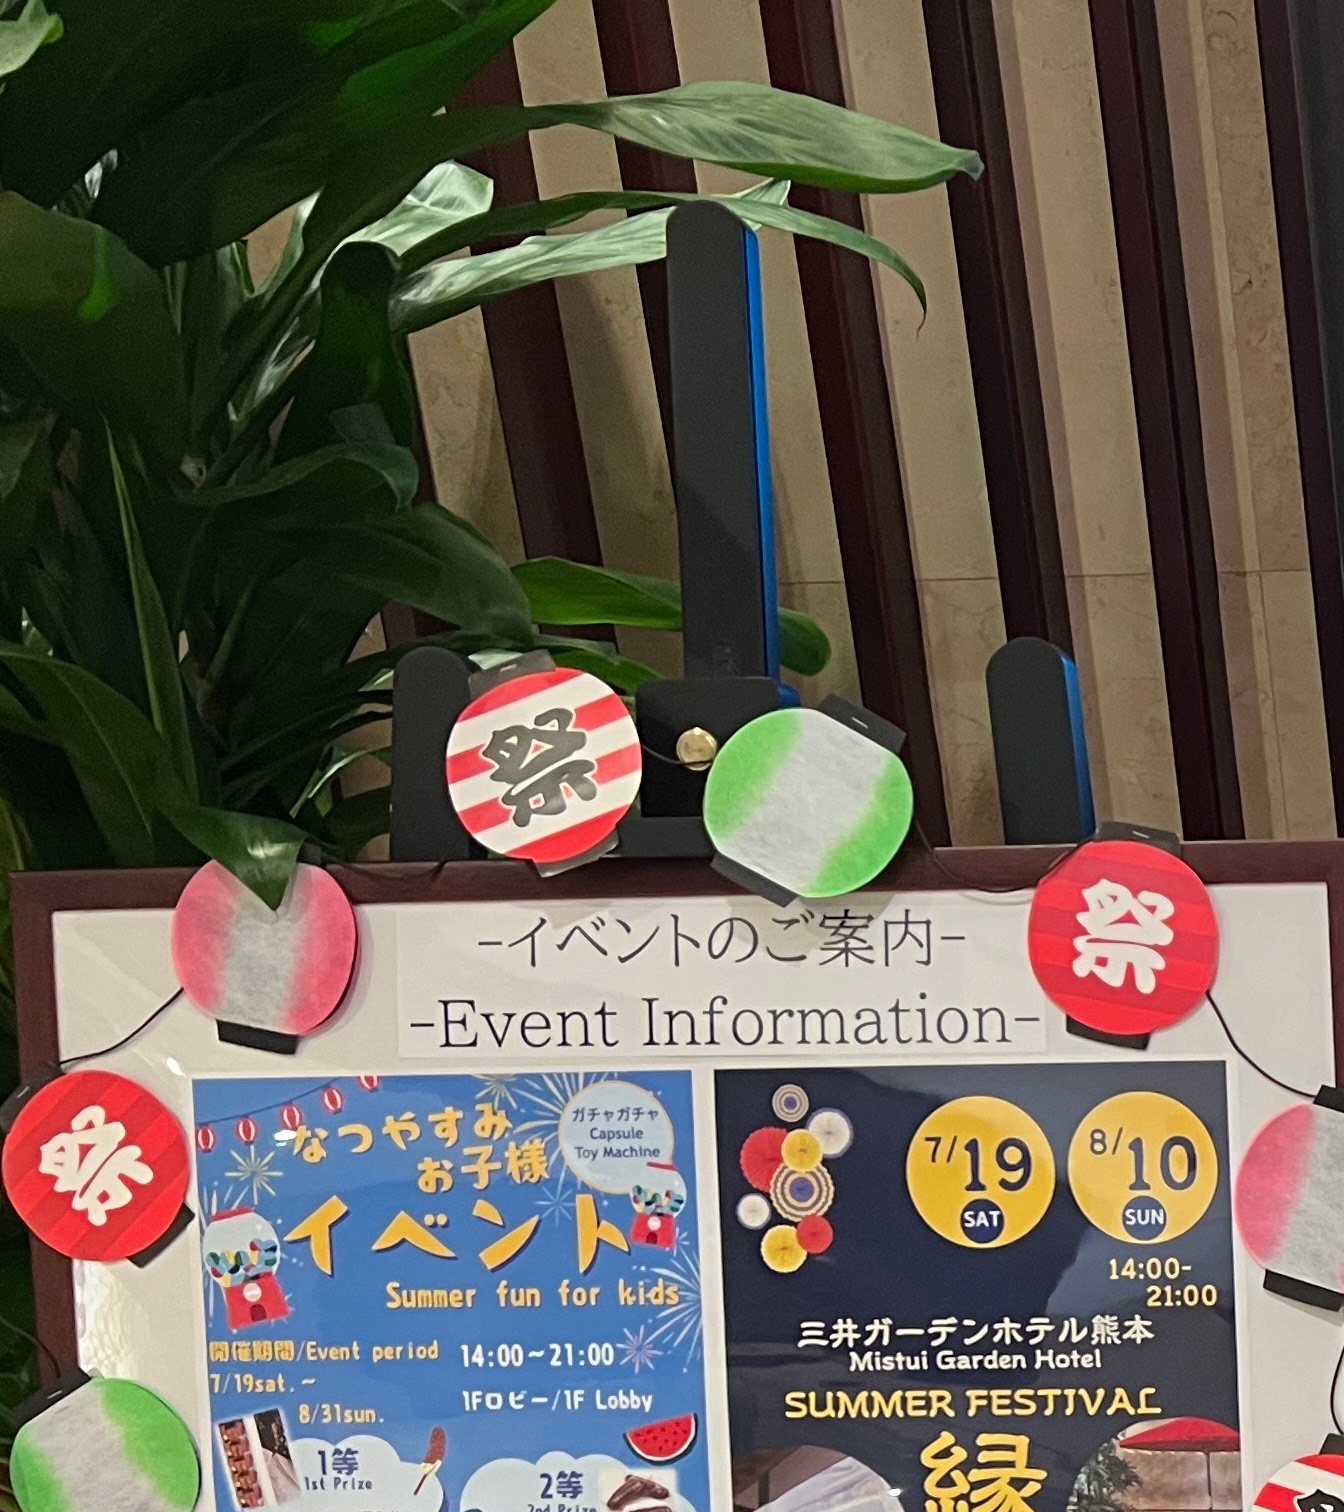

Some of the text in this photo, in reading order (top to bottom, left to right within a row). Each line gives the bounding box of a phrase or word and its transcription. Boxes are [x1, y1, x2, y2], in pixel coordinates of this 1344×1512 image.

[478, 707, 599, 828] 祭
[478, 908, 966, 968] -イベントのご案内-
[1072, 878, 1175, 995] 祭
[571, 1106, 659, 1123] ガチャガチャ
[292, 1103, 514, 1164] なつやすみ
[589, 1127, 644, 1143] Capsule
[39, 1105, 154, 1227] 祭
[417, 1138, 551, 1194] お子様
[574, 1145, 661, 1161] Toy Machine
[925, 1135, 1033, 1192] 7/19
[1089, 1126, 1199, 1192] 8/10
[963, 1209, 1001, 1228] SAT
[1125, 1208, 1165, 1226] SUN
[283, 1193, 631, 1277] イベント
[1108, 1257, 1192, 1280] 14:00-
[385, 1278, 680, 1310] Summer fun for kids
[1146, 1284, 1218, 1308] 21:00
[796, 1313, 1155, 1348] 三井ガーデンホテル熊本
[372, 1339, 440, 1364] period
[848, 1348, 1102, 1372] Mistui Garden Hotel
[299, 1403, 386, 1425] 8/31sun.
[594, 1389, 654, 1413] Lobby
[784, 1387, 1163, 1419] SUMMER FESTIVAL
[317, 1447, 360, 1477] 1等
[304, 1476, 373, 1491] 1st Prize
[539, 1470, 585, 1500] 2等
